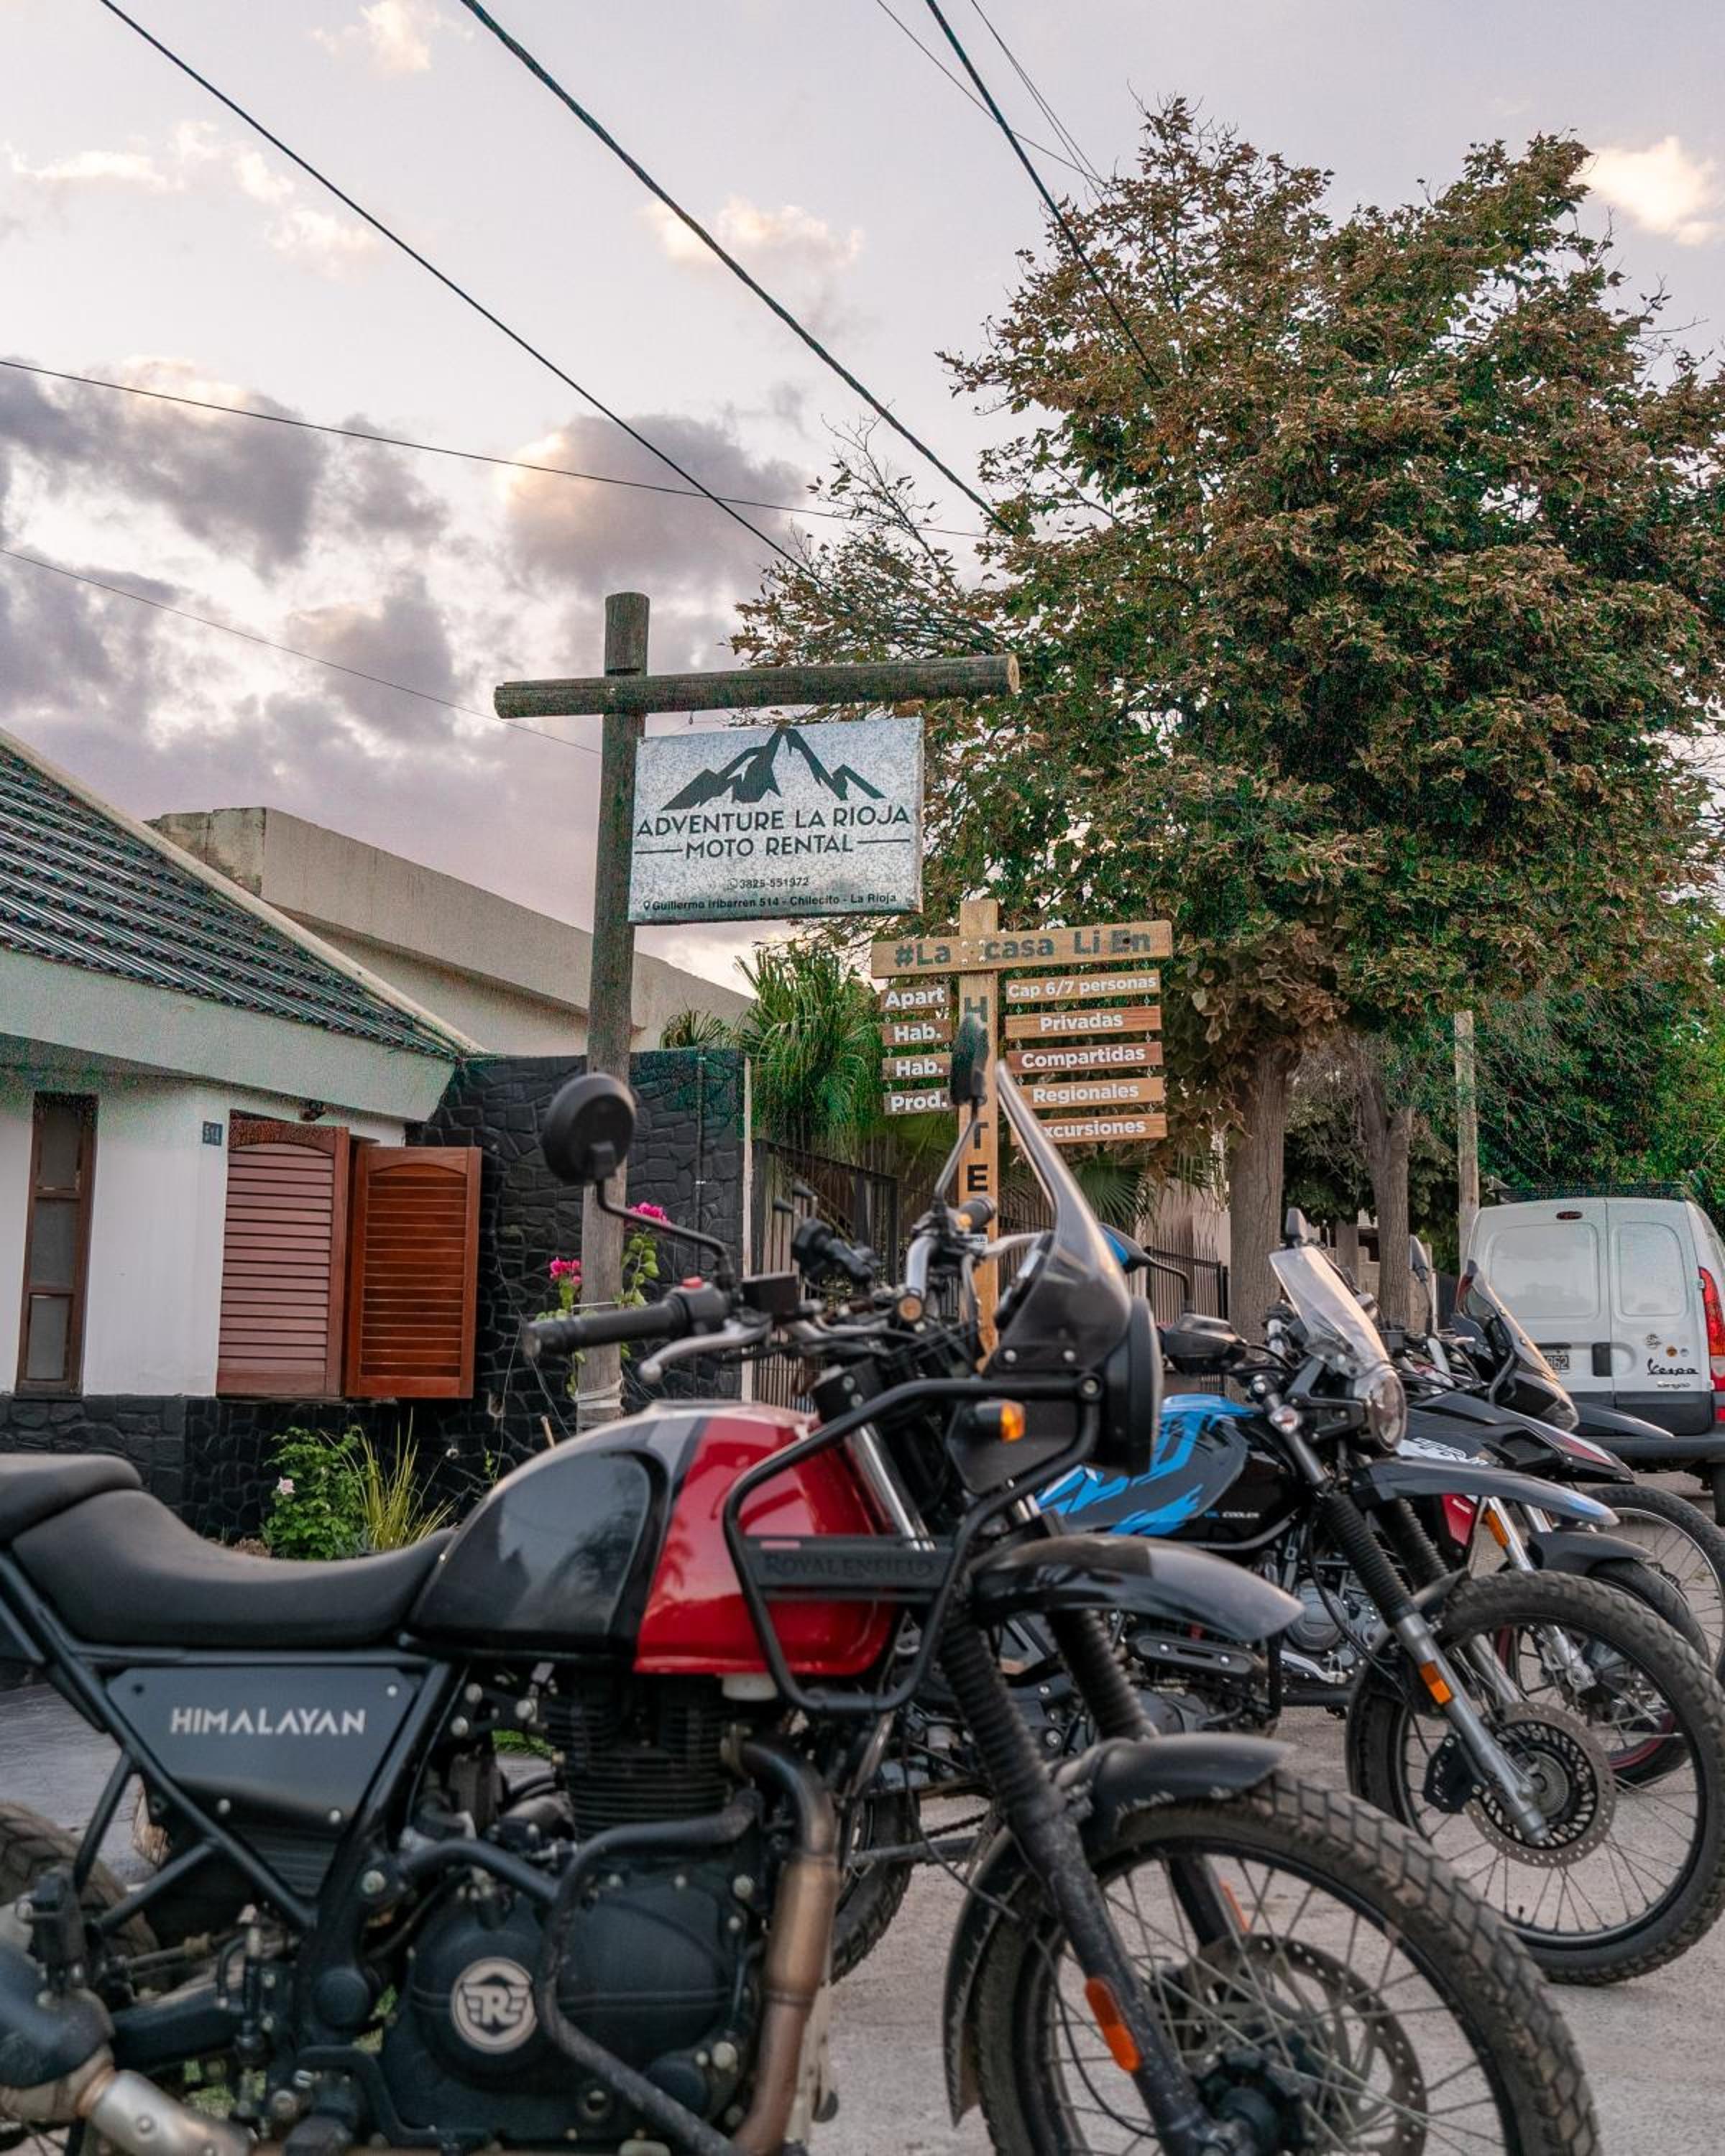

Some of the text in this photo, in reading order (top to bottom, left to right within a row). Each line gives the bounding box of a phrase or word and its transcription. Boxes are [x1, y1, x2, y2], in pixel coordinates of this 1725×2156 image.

[637, 805, 911, 837] ADVENTURE LA RIOJA
[686, 834, 853, 860] MOTO RENTAL
[759, 896, 778, 907] 514
[790, 895, 840, 906] Chilecito
[850, 894, 863, 904] La
[868, 892, 897, 905] Rioja
[895, 943, 951, 967] #La
[985, 938, 1054, 959] casa
[1075, 929, 1100, 955] Li
[1008, 975, 1158, 999] Cap 6/7 personas
[885, 987, 946, 1009] Apart
[893, 1023, 943, 1043] Hab.
[1040, 1013, 1124, 1032] Privadas
[896, 1057, 944, 1077] Hab.
[1021, 1046, 1146, 1069] Compartidas
[891, 1091, 948, 1112] Prod.
[1032, 1084, 1140, 1105] Regionales
[1043, 1120, 1148, 1138] xcursiones
[1647, 1357, 1699, 1376] Vespa
[170, 1707, 367, 1736] HIMALAYAN
